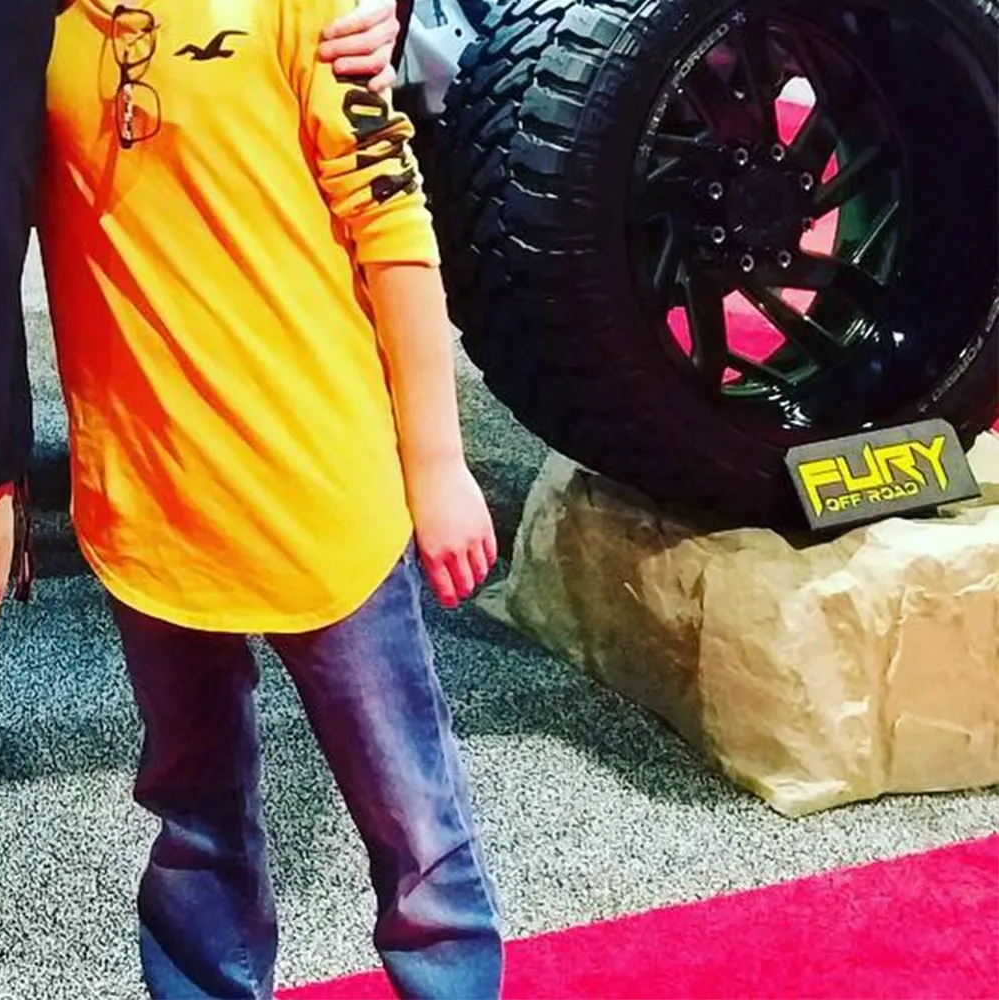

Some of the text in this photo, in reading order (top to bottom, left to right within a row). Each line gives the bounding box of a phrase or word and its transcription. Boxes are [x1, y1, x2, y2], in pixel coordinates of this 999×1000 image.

[798, 435, 949, 518] FURY
[825, 481, 919, 512] OFF ROAD
